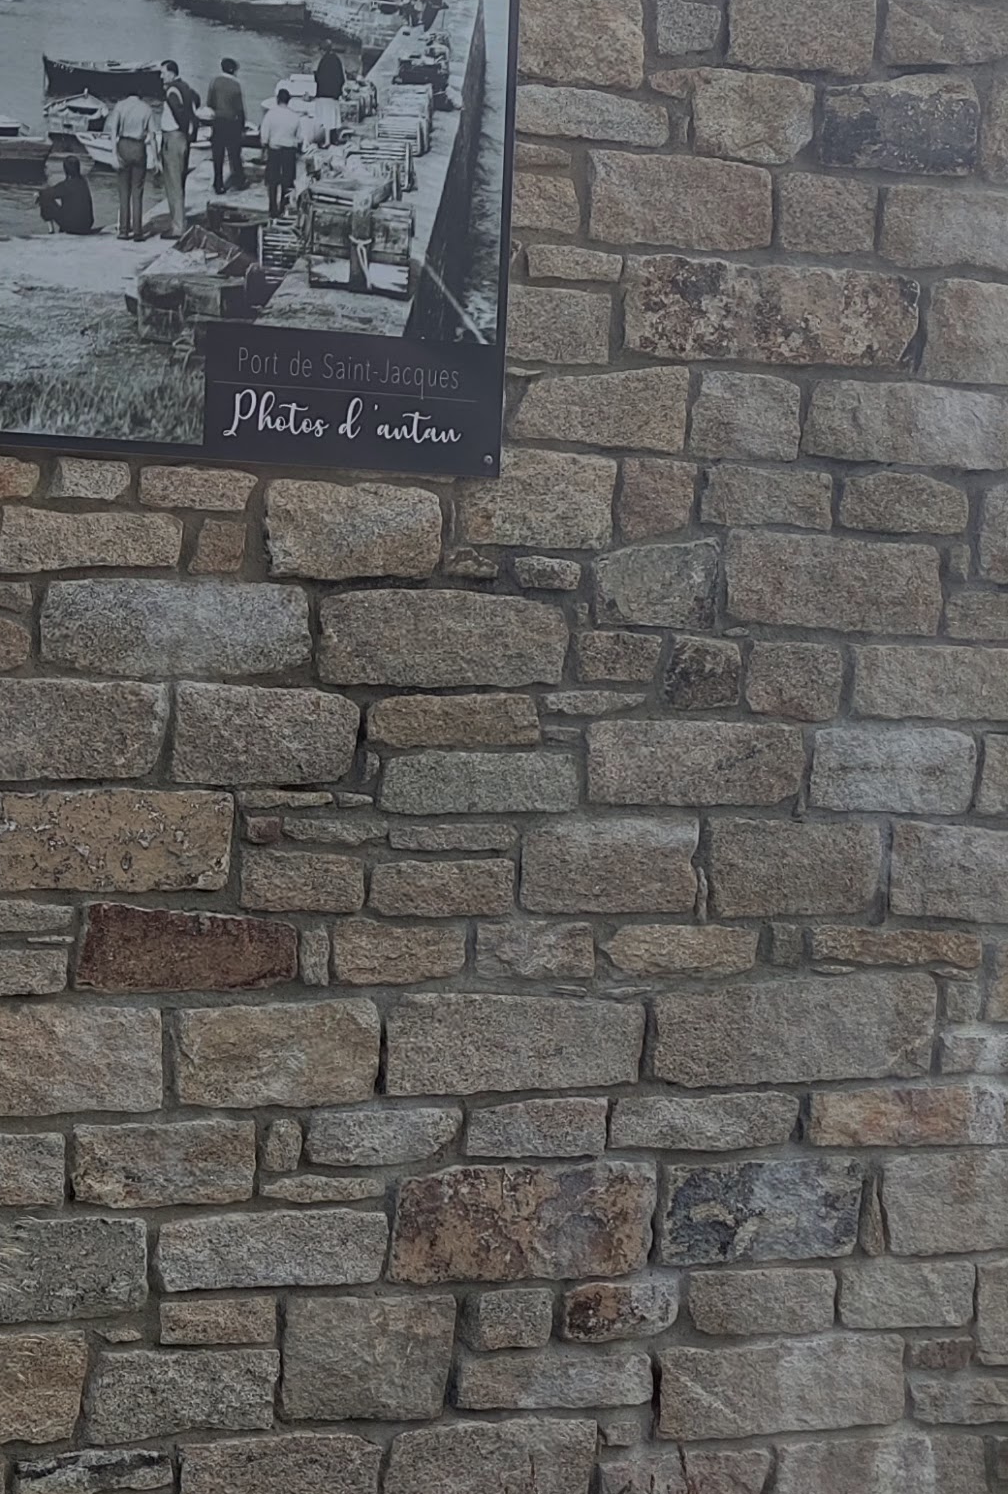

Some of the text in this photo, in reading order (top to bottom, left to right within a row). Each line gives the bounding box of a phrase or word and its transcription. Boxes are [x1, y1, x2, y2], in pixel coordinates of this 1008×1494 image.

[238, 346, 460, 400] Port de Saint-Jacques
[222, 388, 329, 438] Photos
